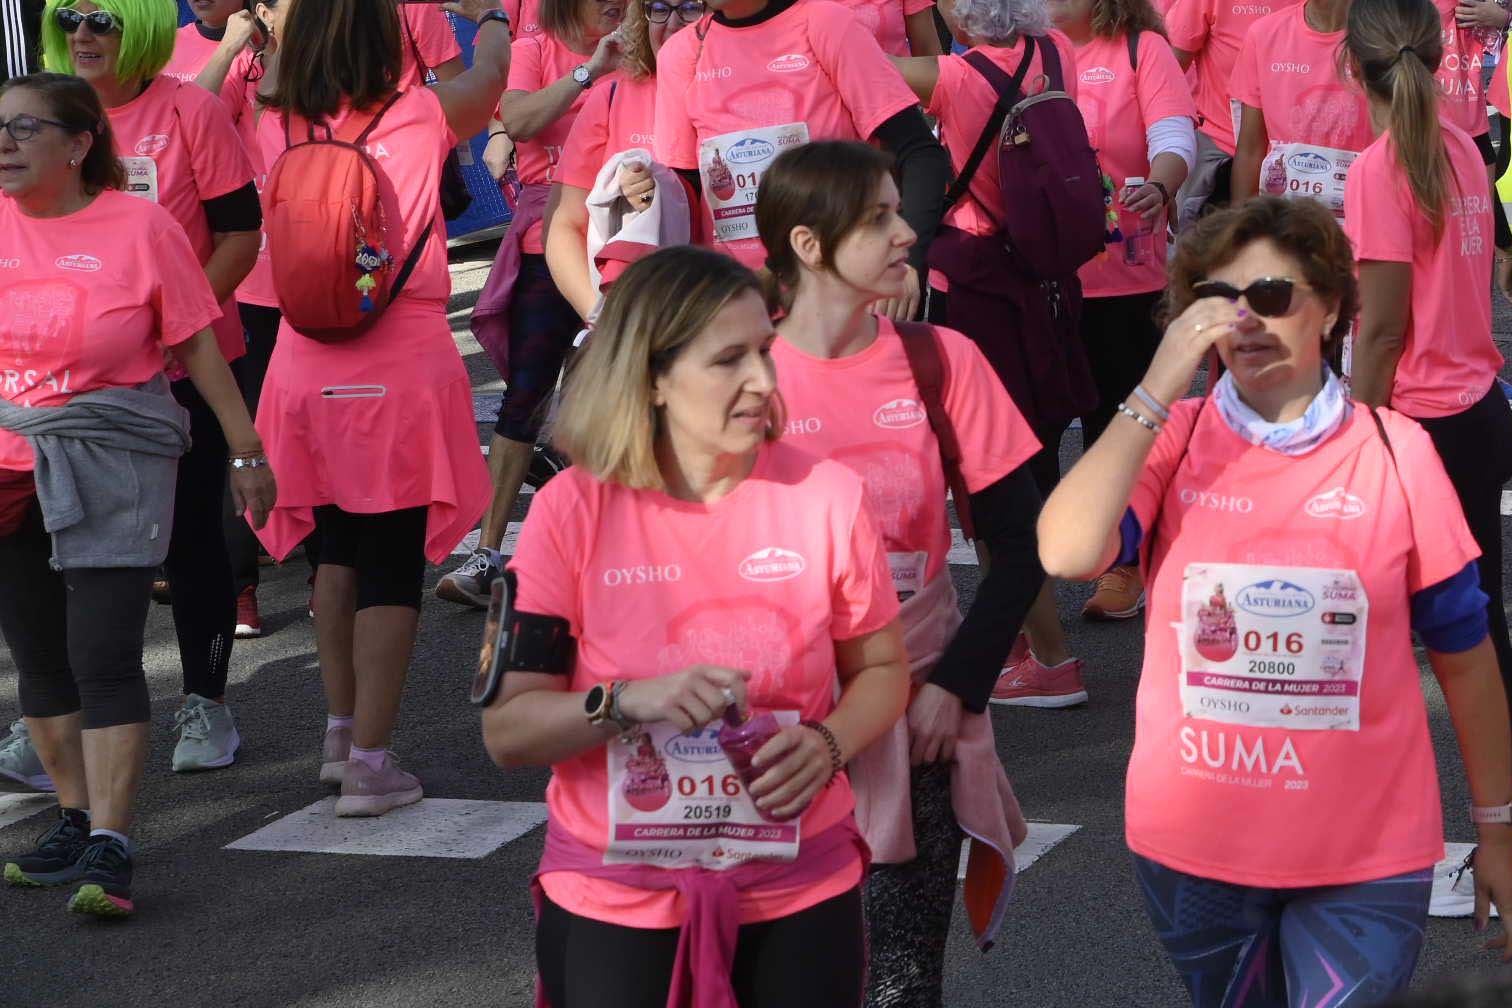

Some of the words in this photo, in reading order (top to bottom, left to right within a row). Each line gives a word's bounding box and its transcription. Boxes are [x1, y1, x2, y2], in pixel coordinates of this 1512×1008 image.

[1231, 4, 1271, 15] OYSHO
[1271, 63, 1311, 75] OYSHO
[1289, 178, 1323, 194] 016
[720, 221, 749, 234] OYSHO
[1179, 489, 1253, 514] OYSHO
[603, 564, 682, 588] OYSHO
[1240, 592, 1309, 610] ASTURIANA
[1322, 591, 1357, 601] SUMA
[1243, 629, 1305, 655] 016
[1248, 659, 1296, 676] 20800
[1203, 675, 1250, 690] CARRERA
[1251, 679, 1267, 691] DE
[1267, 682, 1282, 692] LA
[1282, 682, 1320, 694] MUJER
[1200, 696, 1251, 713] OYSHO
[1294, 704, 1349, 717] Santander
[671, 741, 722, 756] ASTURI
[1179, 726, 1305, 776] SUMA
[677, 773, 741, 797] 016
[1284, 779, 1309, 791] 2023
[683, 804, 732, 820] 20519
[633, 827, 685, 837] CARRERA
[686, 827, 701, 837] DE
[703, 826, 717, 837] LA
[718, 825, 754, 838] MUJER
[624, 847, 683, 859] OYSHO
